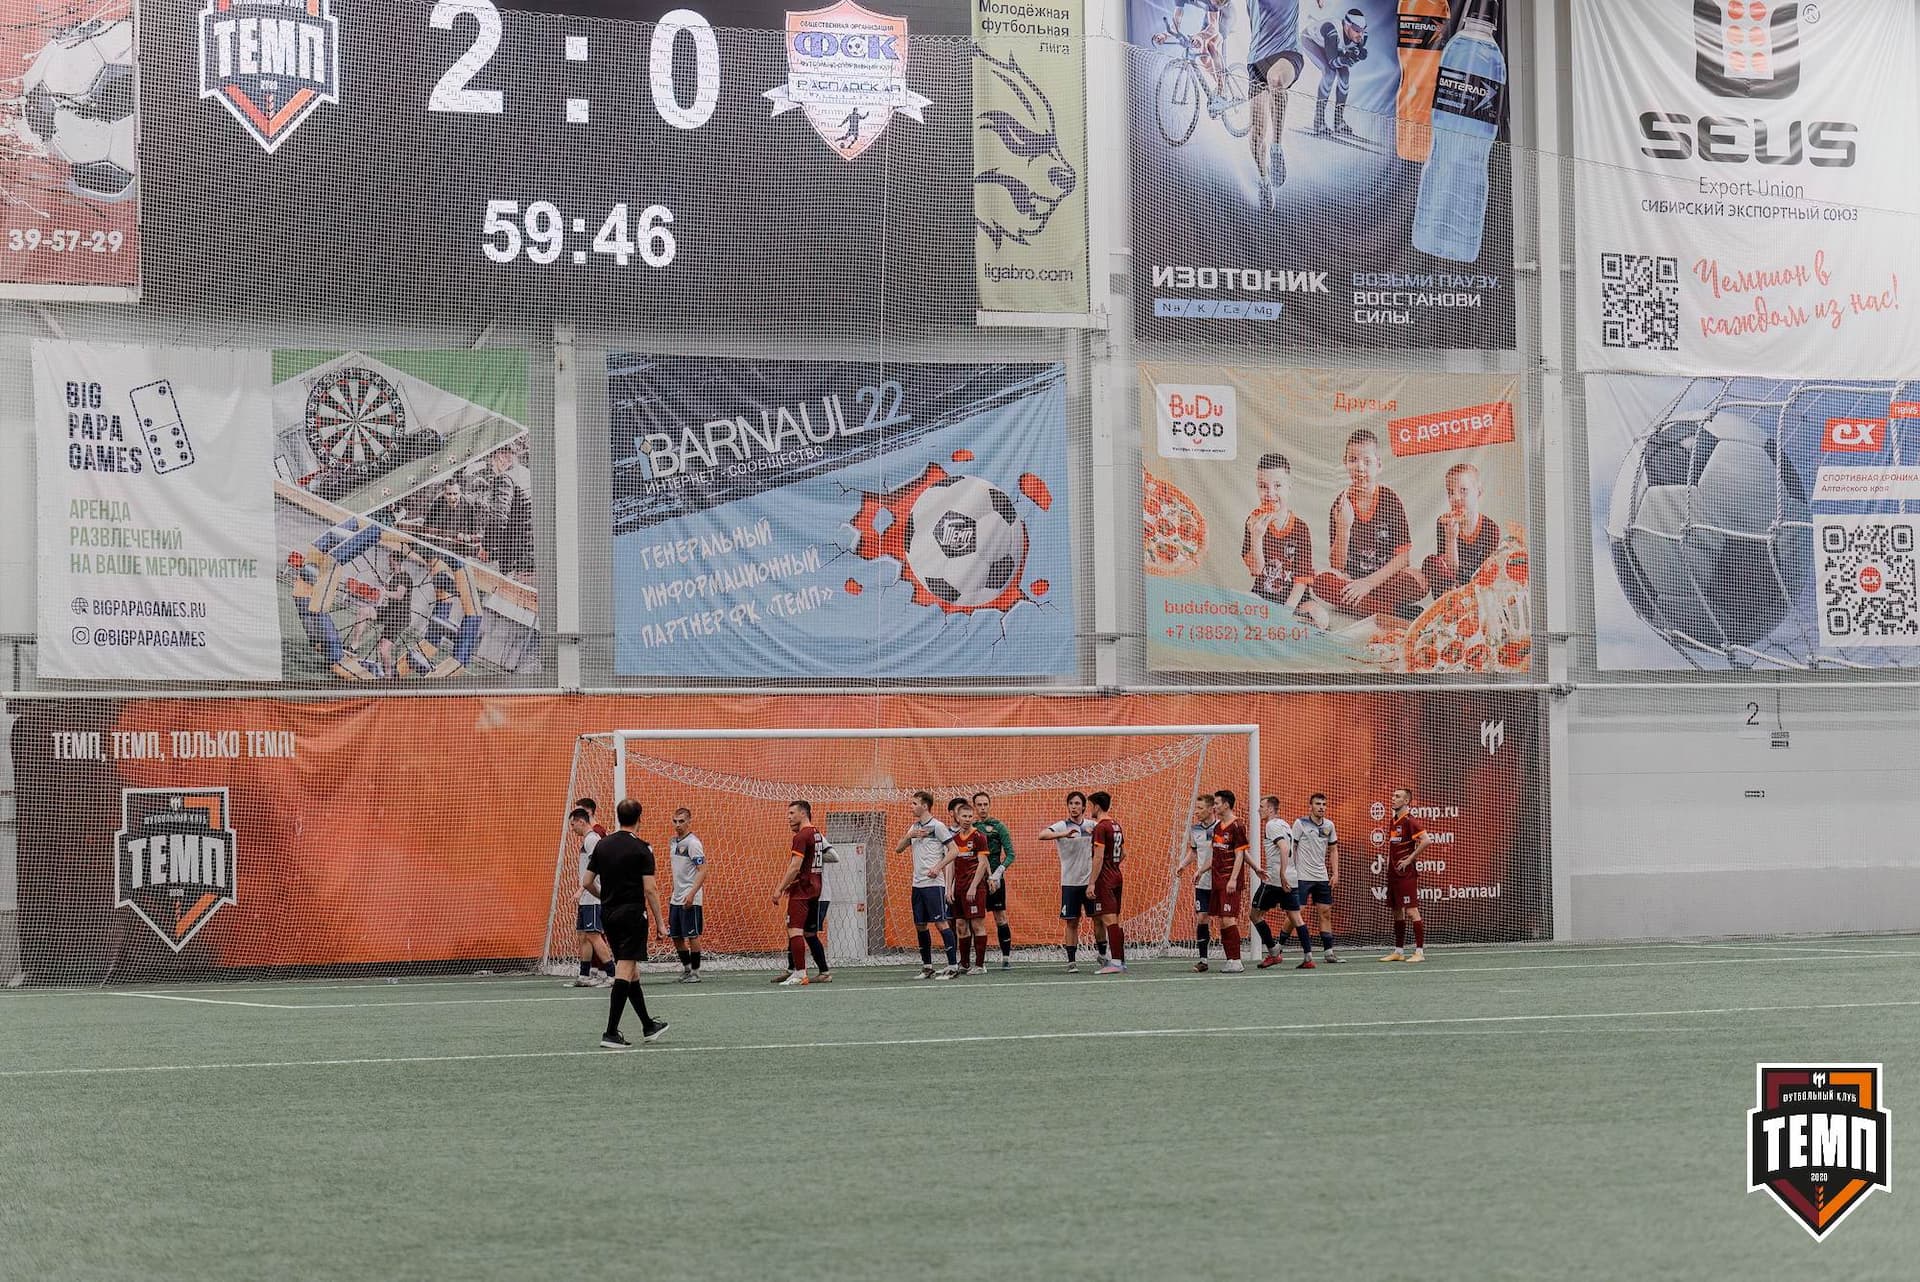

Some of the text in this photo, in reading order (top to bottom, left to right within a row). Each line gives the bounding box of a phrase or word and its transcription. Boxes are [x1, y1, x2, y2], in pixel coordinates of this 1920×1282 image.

[979, 0, 1070, 20] Молодёжная
[981, 18, 1070, 37] футбольная
[213, 18, 325, 83] ТЕМП
[794, 31, 900, 60] ФСК
[1039, 42, 1070, 55] лига
[428, 0, 503, 114] 2
[650, 9, 720, 129] 0
[1639, 111, 1858, 168] SEUS
[1699, 176, 1804, 199] Export Union
[1641, 199, 1858, 221] СИБИРСКИЙ ЭКСПОРТНЫЙ СОЮЗ
[9, 228, 123, 253] 39-57-29
[482, 200, 677, 268] 59:46
[984, 263, 1073, 283] ligabro.com
[1152, 265, 1329, 293] ИЗОТОНИК
[1353, 273, 1433, 287] ВОЗЬМИ
[1692, 258, 1810, 299] Чемпион
[1353, 292, 1481, 307] ВОССТАНОВИ
[1700, 272, 1900, 338] каждом из нас!
[1354, 310, 1415, 324] СИЛЫ.
[66, 381, 102, 409] BIG
[1334, 392, 1397, 414] Друзья
[68, 412, 123, 442] PAPA
[1172, 421, 1224, 437] FOOD
[1417, 413, 1494, 443] детства
[69, 443, 143, 474] GAMES
[1821, 484, 1868, 493] Алтайского
[70, 499, 132, 523] АРЕНДА
[70, 526, 183, 550] РАЗВЛЕЧЕНИЙ
[640, 516, 773, 571] ГЕНЕРАЛЬНЫЙ
[71, 553, 258, 579] НА ВАШЕ МЕРОПРИЯТИЕ
[641, 543, 821, 611] ИНФОРМАЦИОННЫЙ
[93, 600, 206, 618] BIGPAPAGAMES.RU
[1164, 600, 1269, 619] budufood.org
[641, 608, 724, 649] ПАРТНЕР
[730, 600, 762, 627] ФК
[1189, 625, 1240, 643] (3852)
[94, 628, 206, 647] @BIGPAPAGAMES
[1746, 701, 1759, 725] 2
[52, 731, 297, 762] ТЕМП, ТЕМП, ТОЛЬКО ТЕМП!
[127, 834, 225, 889] ТЕМП
